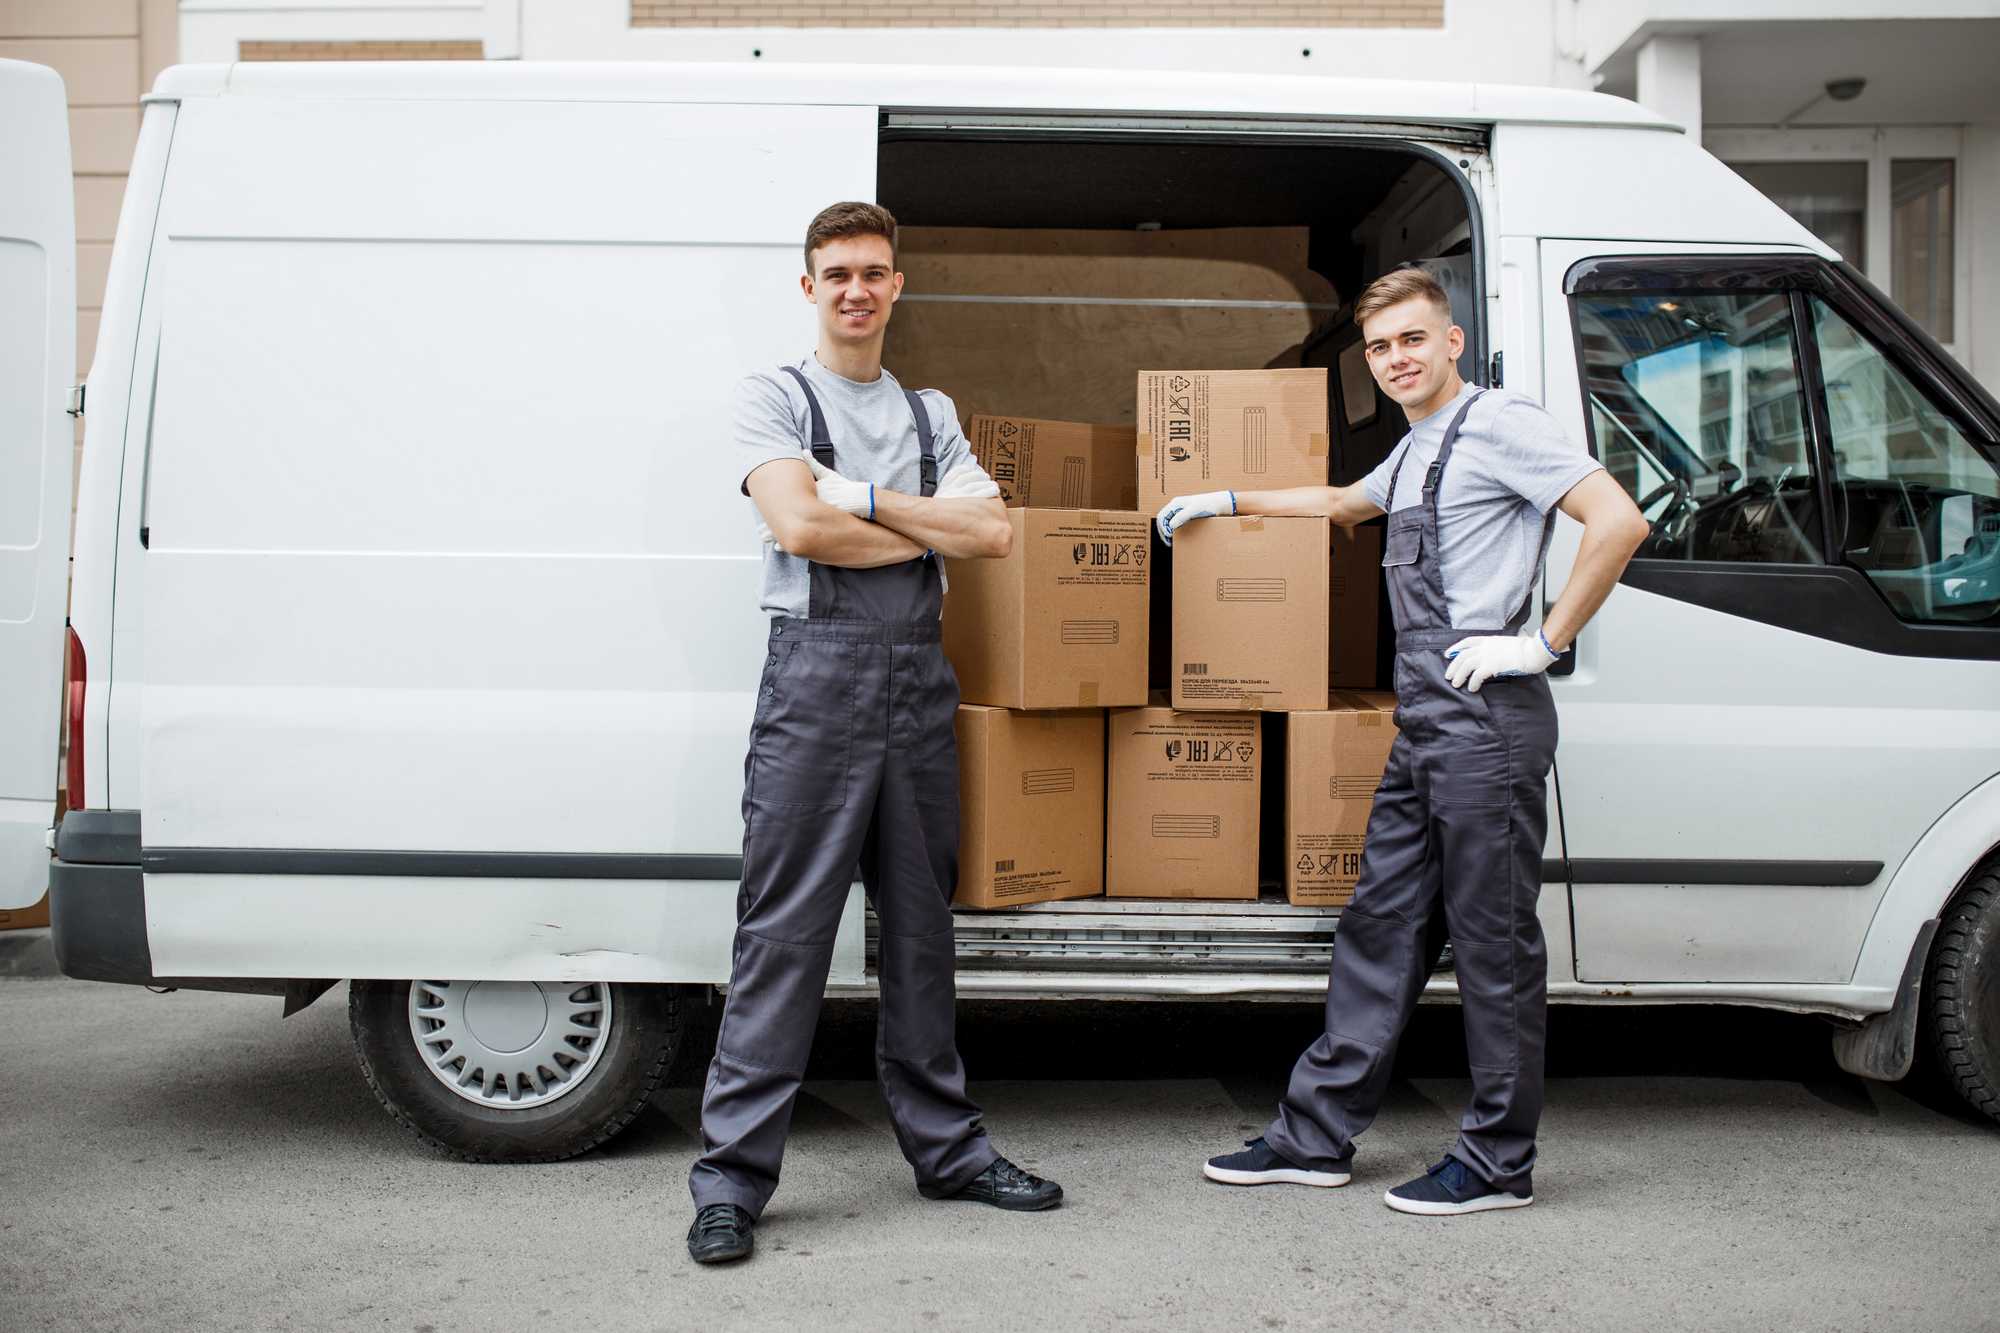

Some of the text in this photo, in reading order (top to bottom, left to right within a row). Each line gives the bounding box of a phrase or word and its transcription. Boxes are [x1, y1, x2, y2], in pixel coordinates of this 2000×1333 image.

[1169, 420, 1191, 441] EAC
[1090, 543, 1110, 566] EAC
[1186, 740, 1209, 762] EAC
[1343, 853, 1363, 876] EA
